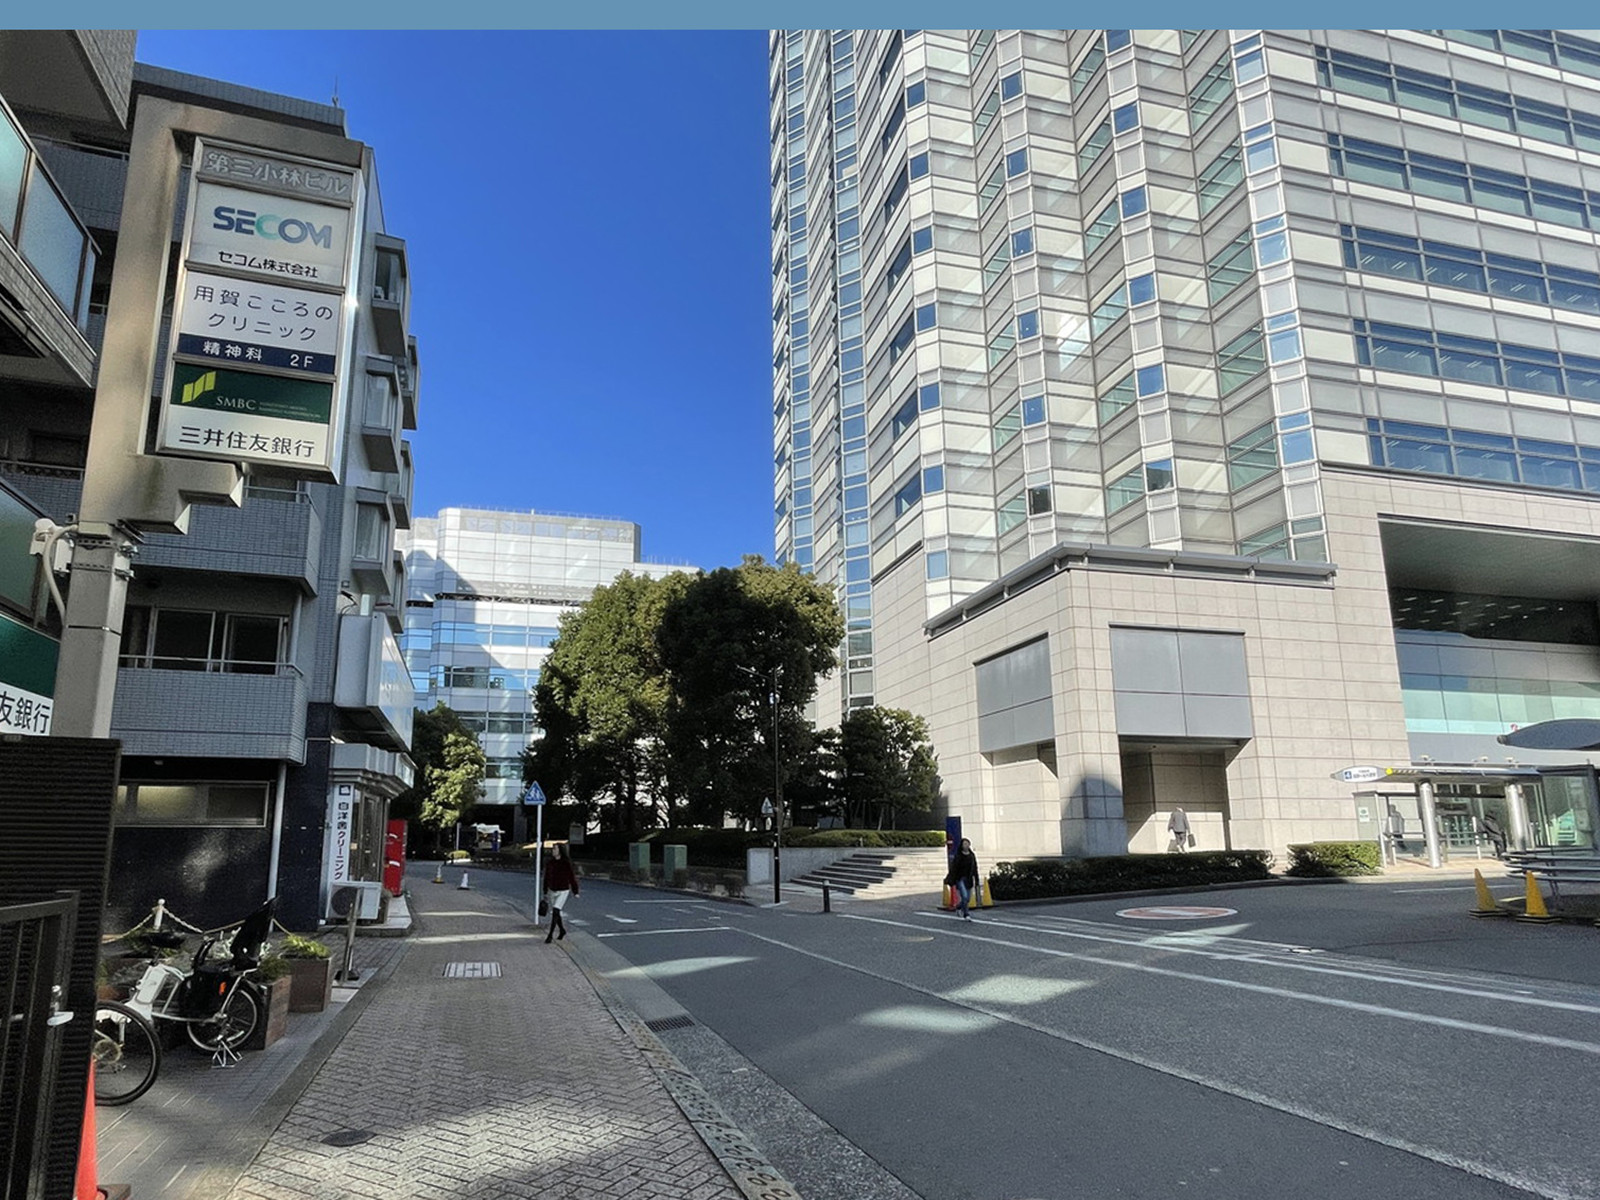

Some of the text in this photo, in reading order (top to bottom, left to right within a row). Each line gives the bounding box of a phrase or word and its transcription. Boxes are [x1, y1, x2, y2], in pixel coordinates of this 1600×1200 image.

[206, 151, 348, 195] 第三小林ビル
[213, 205, 333, 249] SECOM
[218, 250, 319, 279] セコム株式会社
[194, 285, 333, 321] 用賀こころの
[208, 312, 316, 341] クリニック
[202, 340, 314, 368] 精神科 2F
[215, 395, 257, 411] SMBC
[179, 425, 315, 458] 三井住友銀行
